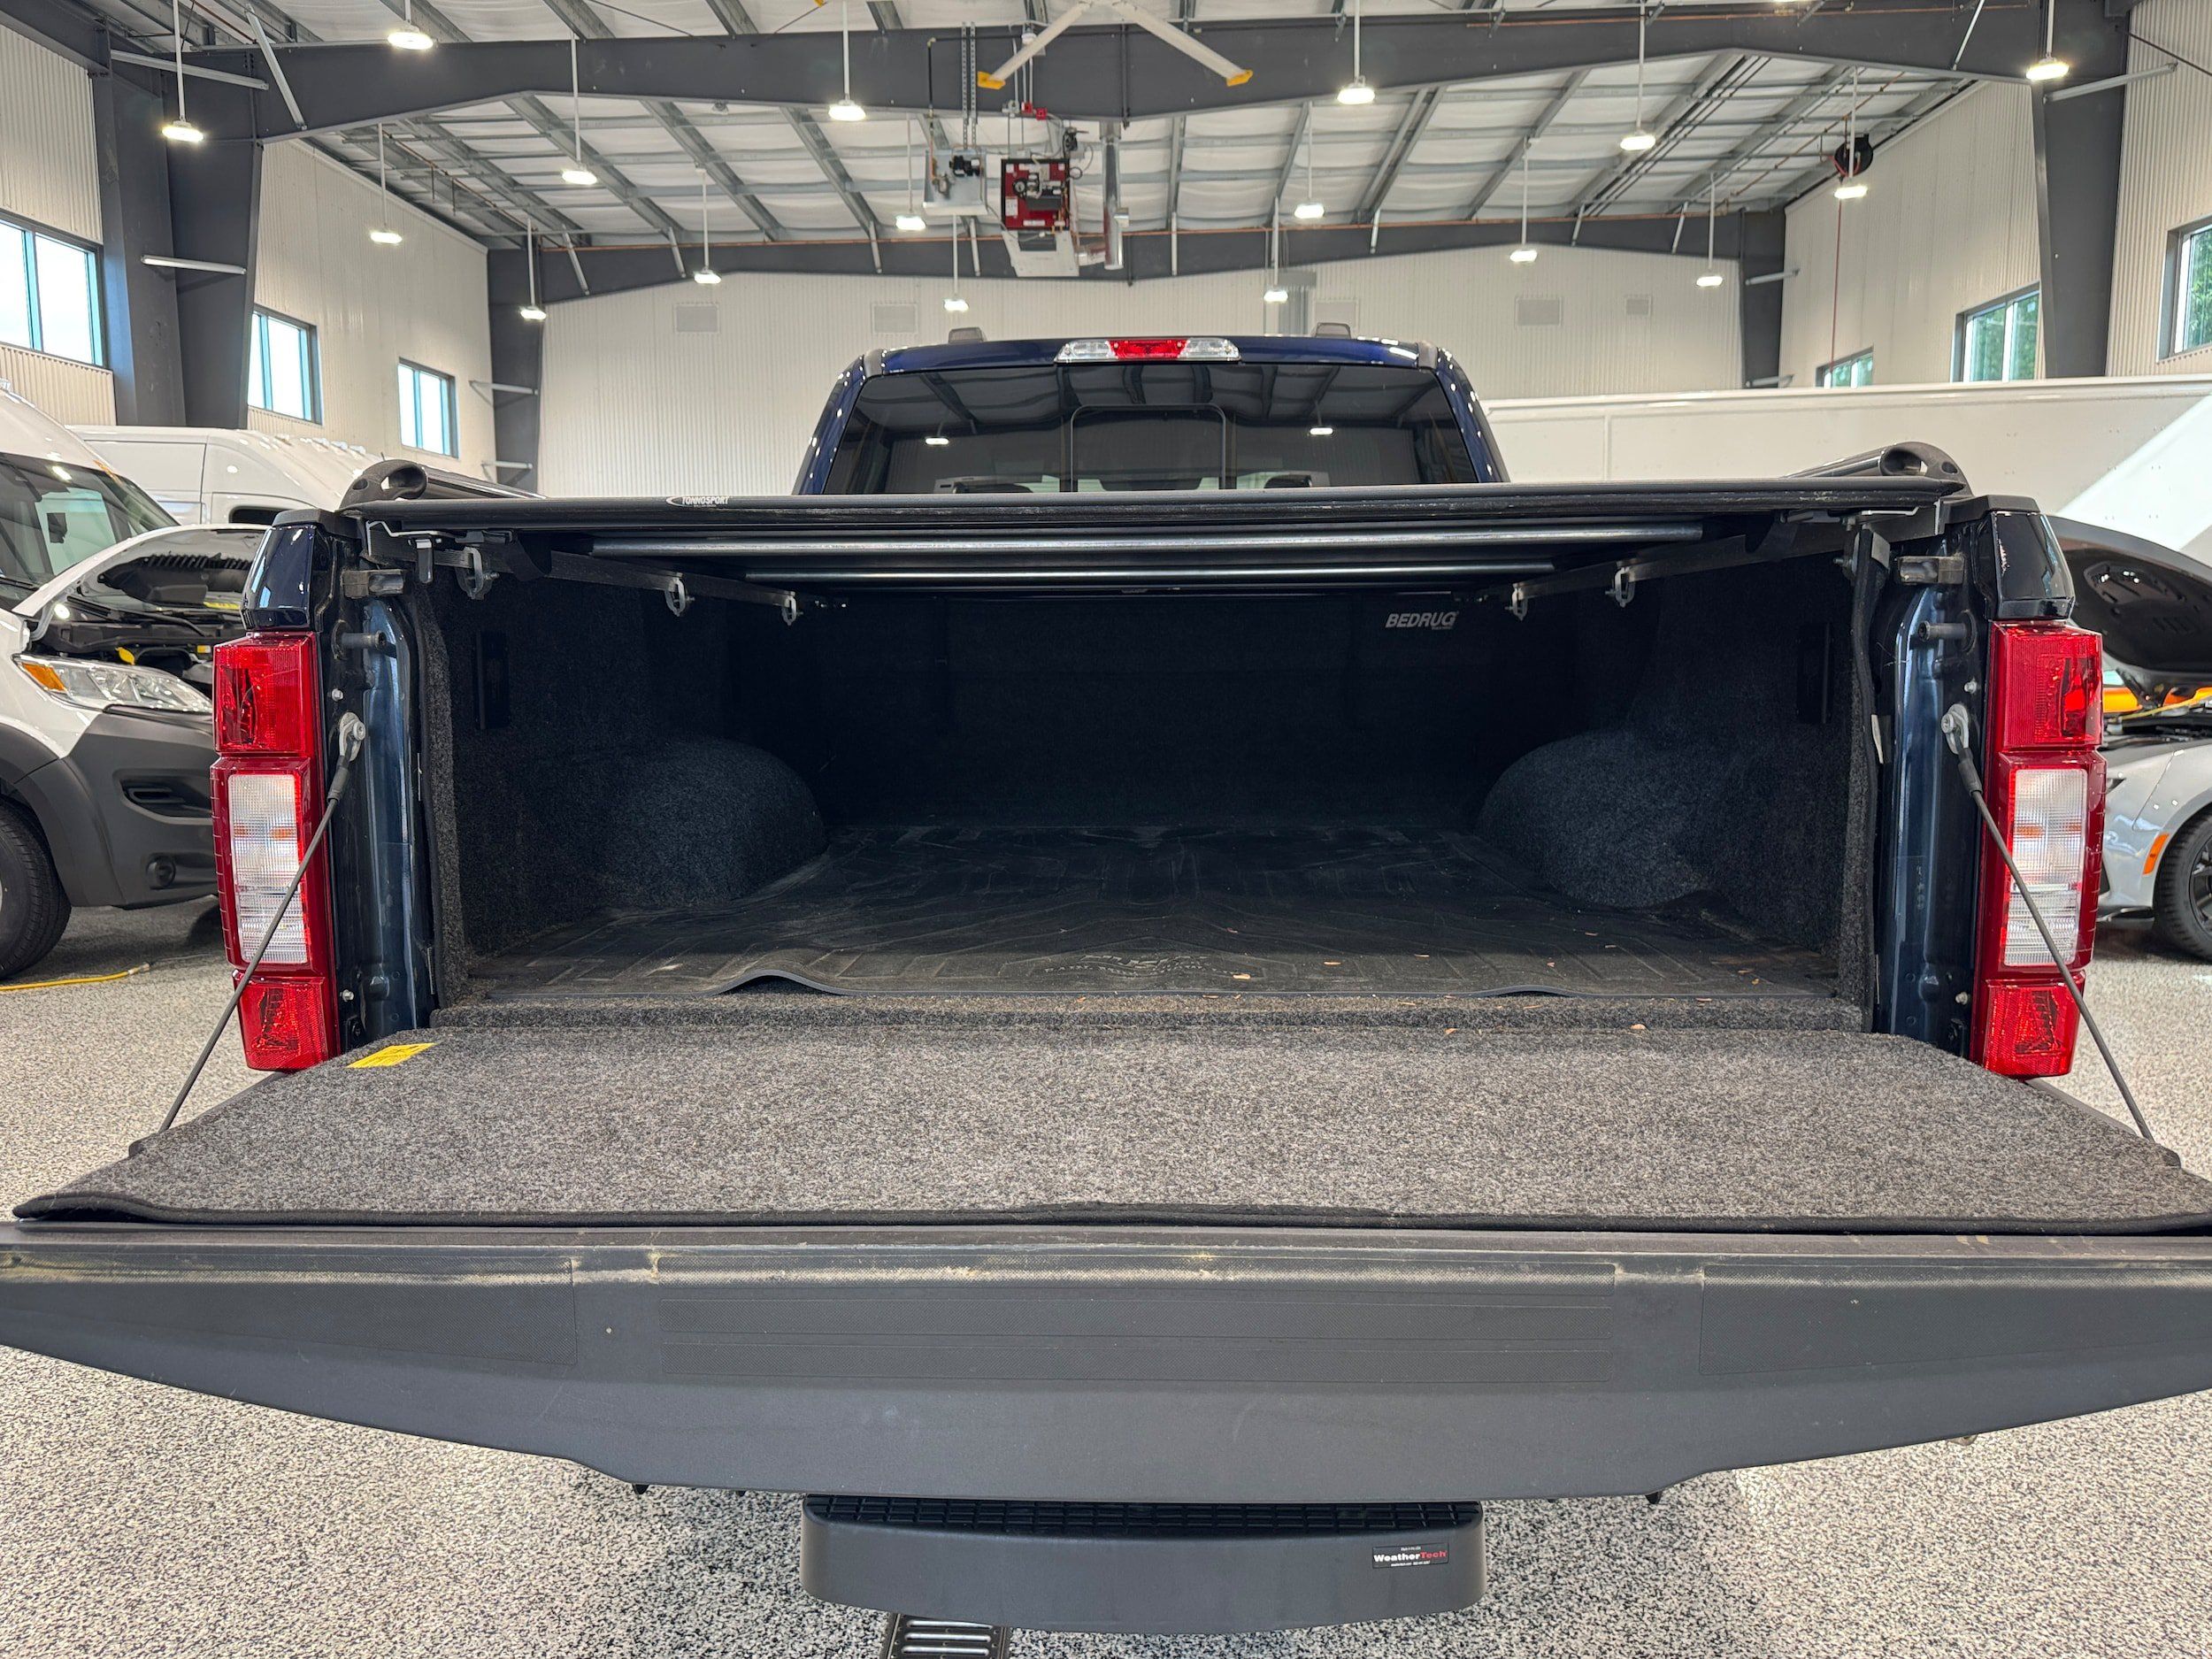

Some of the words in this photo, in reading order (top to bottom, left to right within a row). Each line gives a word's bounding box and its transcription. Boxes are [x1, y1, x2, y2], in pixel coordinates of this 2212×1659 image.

[682, 496, 730, 505] TONNOSPORT
[1385, 612, 1457, 628] BEDRUG
[1373, 1550, 1447, 1563] WeatherTech
